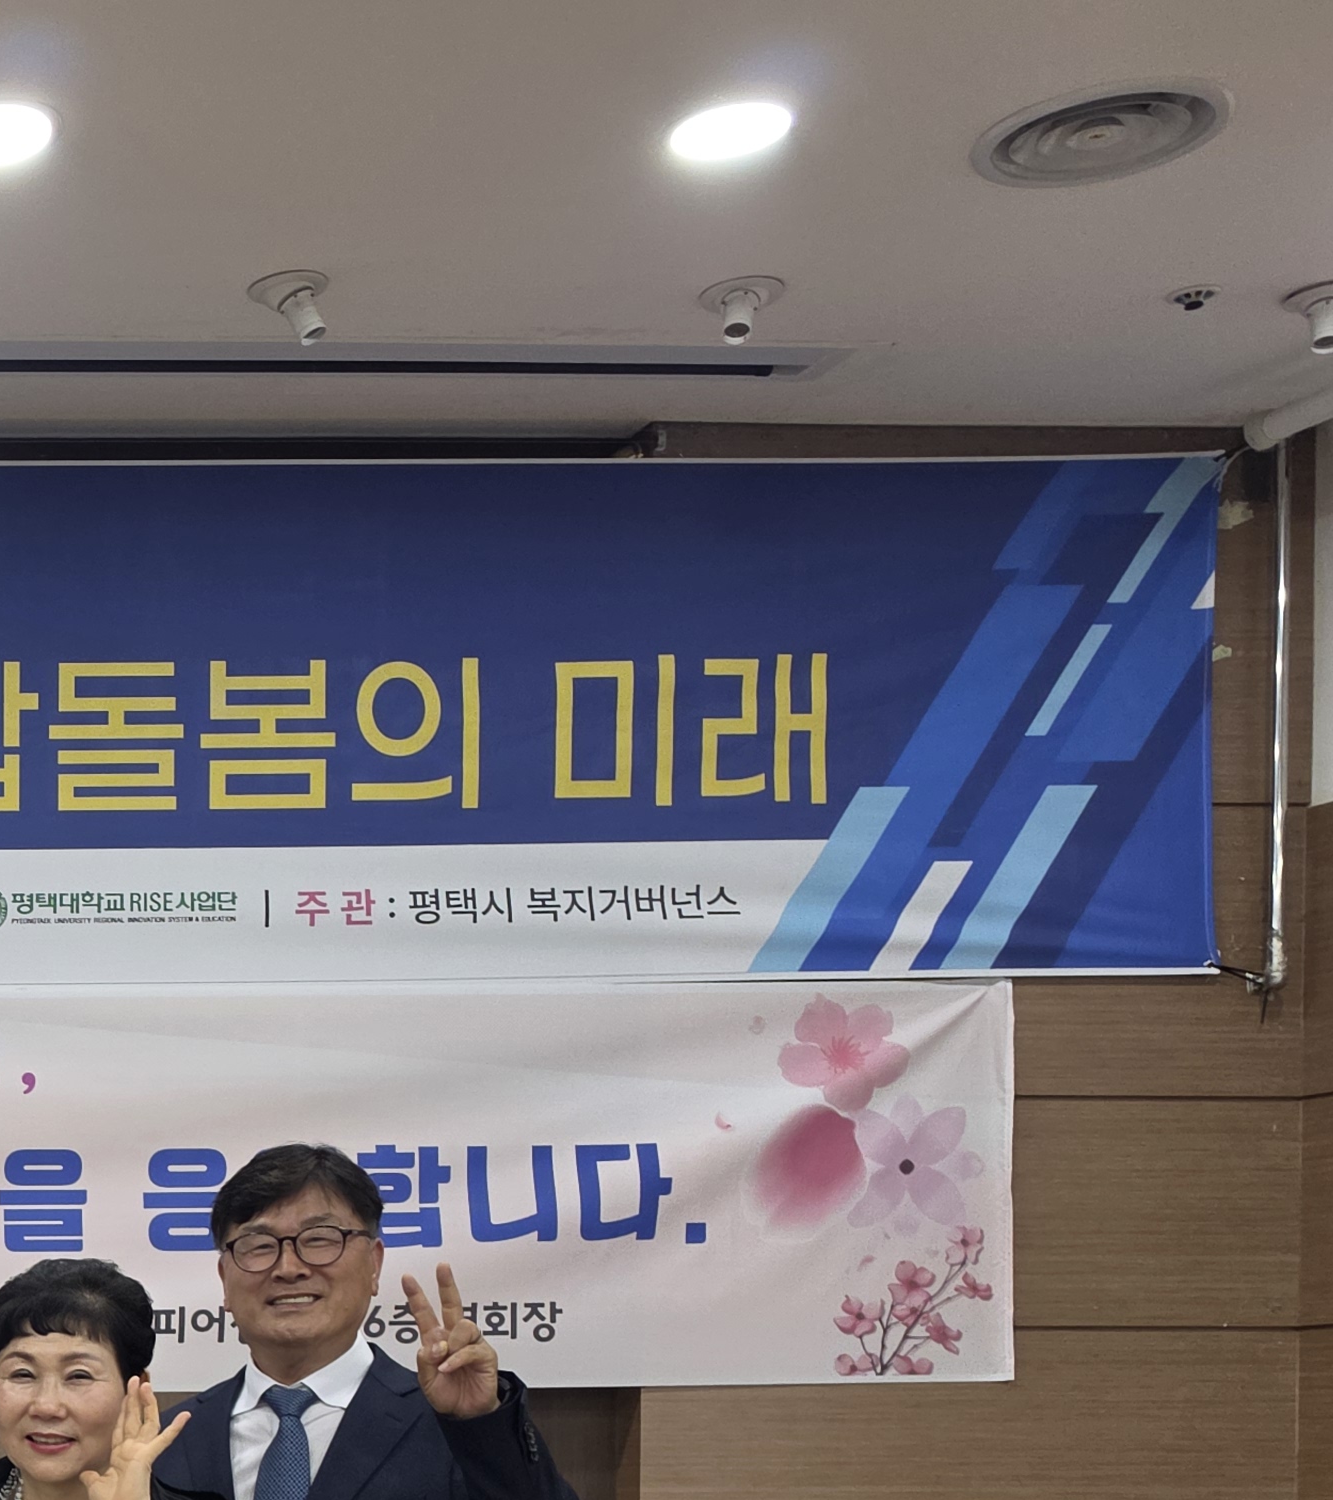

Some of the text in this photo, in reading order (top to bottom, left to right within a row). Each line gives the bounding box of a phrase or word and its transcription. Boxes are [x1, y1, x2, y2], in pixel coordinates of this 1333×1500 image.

[553, 652, 828, 807] 미래
[408, 886, 513, 925] 평택시
[526, 883, 741, 923] 복지거버넌스
[143, 1142, 707, 1252] 응합니다.
